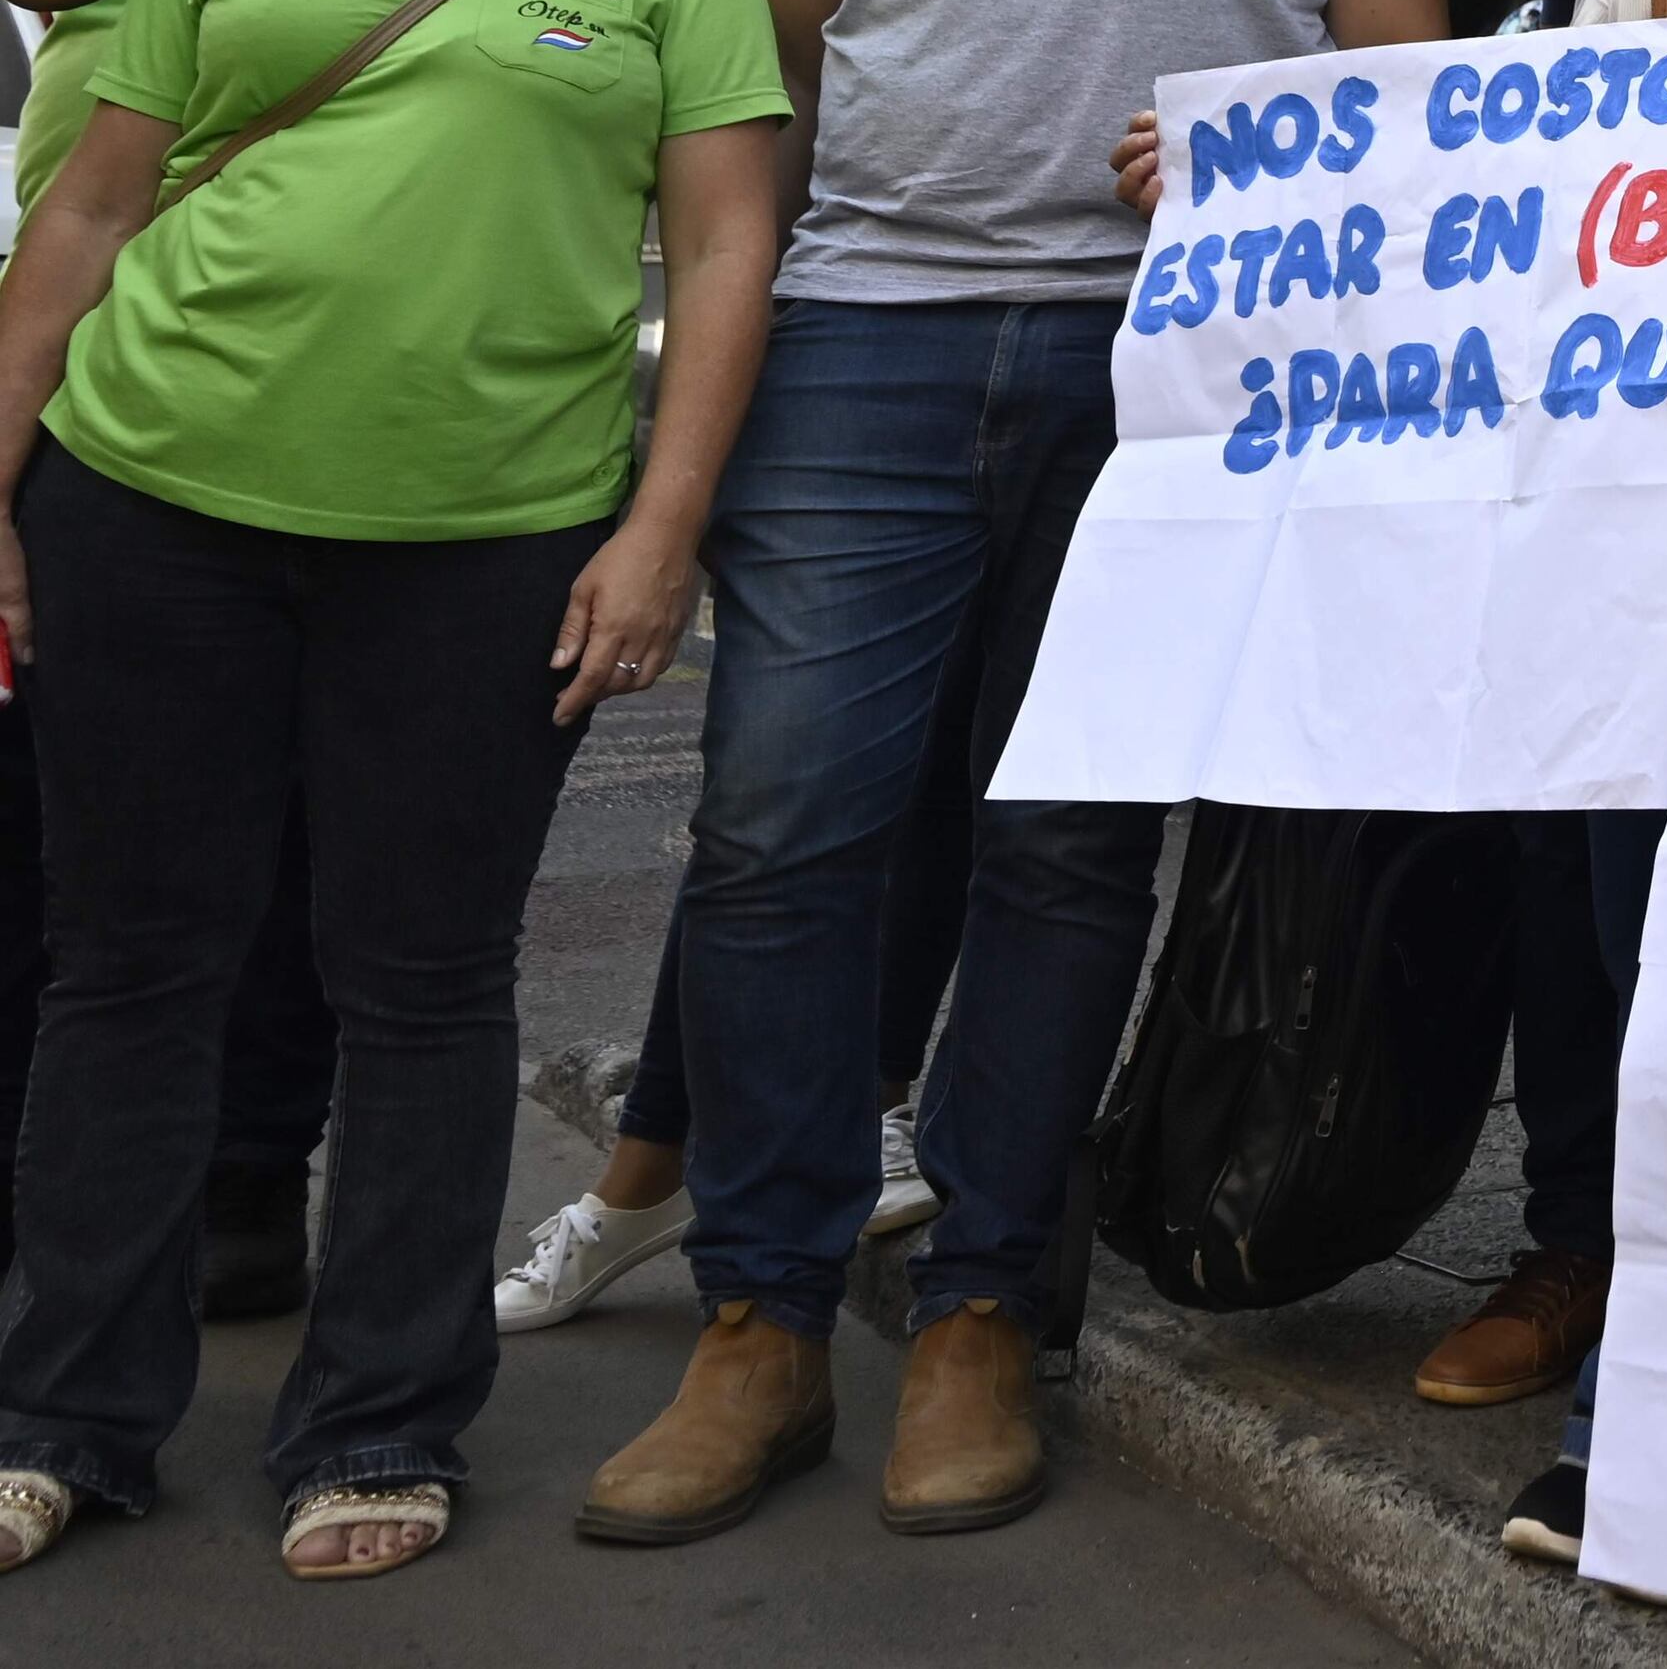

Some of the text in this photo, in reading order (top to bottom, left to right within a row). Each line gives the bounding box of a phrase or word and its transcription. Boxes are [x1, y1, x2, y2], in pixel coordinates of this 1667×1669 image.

[1191, 76, 1380, 207] NOS
[1130, 202, 1386, 336] ESTAR
[1423, 185, 1543, 292] EN
[1222, 326, 1505, 475] ¿PARA
